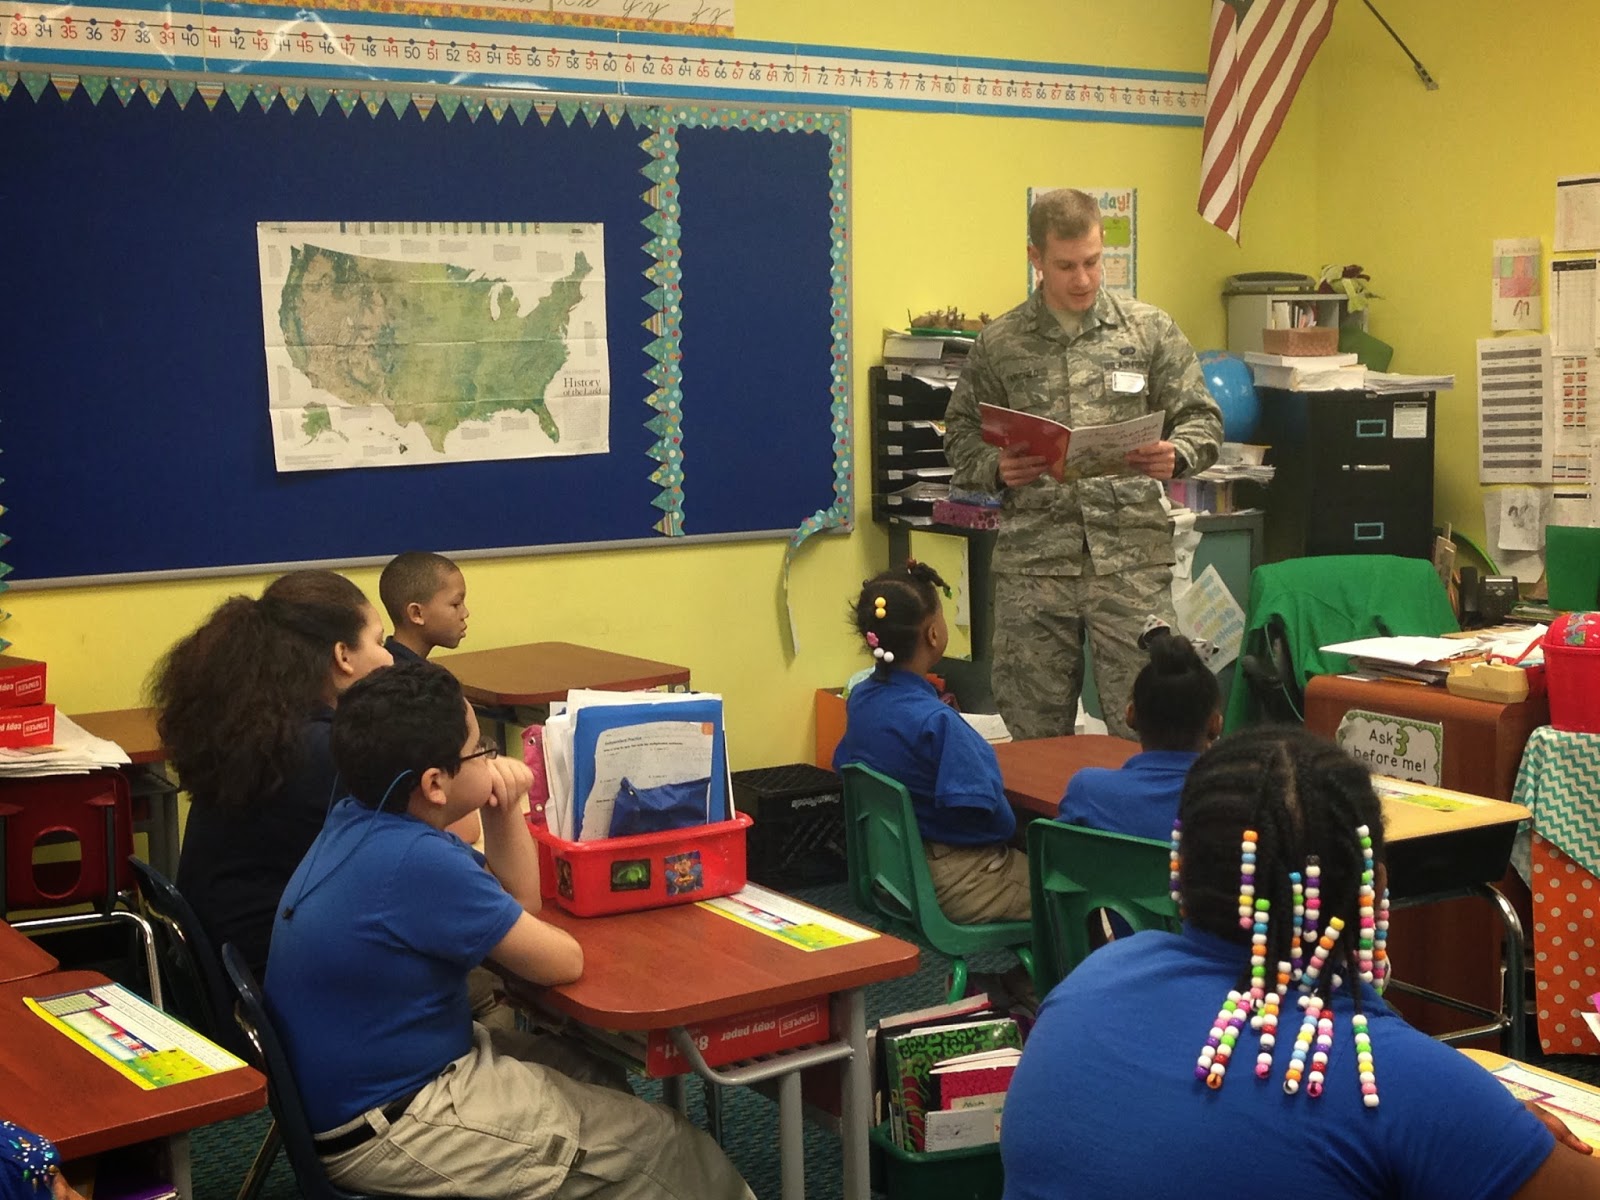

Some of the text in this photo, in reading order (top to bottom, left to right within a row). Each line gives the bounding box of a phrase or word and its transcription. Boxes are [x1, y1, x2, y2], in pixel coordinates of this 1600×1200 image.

[10, 22, 27, 37] 33
[35, 23, 52, 38] 34
[60, 25, 78, 40] 35
[86, 26, 102, 41] 36
[110, 28, 126, 43] 37
[135, 29, 151, 44] 38
[159, 31, 176, 46] 39
[182, 32, 199, 47] 40
[208, 34, 221, 48] 41
[230, 35, 245, 50] 42
[252, 37, 269, 51] 43
[296, 40, 314, 54] 45
[319, 41, 335, 56] 46
[340, 42, 356, 57] 47
[361, 44, 377, 58] 48
[383, 45, 398, 60] 49
[404, 46, 421, 61] 50
[427, 47, 438, 61] 51
[446, 49, 460, 62] 52
[467, 50, 481, 63] 53
[487, 51, 501, 65] 54
[506, 52, 521, 66] 55
[527, 54, 541, 67] 56
[547, 55, 560, 69] 57
[566, 56, 580, 70] 58
[585, 58, 598, 71] 59
[603, 59, 617, 72] 60
[625, 60, 635, 73] 61
[642, 62, 655, 74] 62
[661, 63, 673, 75] 63
[678, 64, 691, 77] 64
[697, 65, 710, 78] 65
[714, 66, 727, 79] 66
[732, 67, 744, 80] 67
[749, 68, 761, 81] 68
[767, 70, 778, 82] 69
[783, 71, 794, 83] 70
[801, 72, 810, 84] 71
[817, 73, 828, 86] 72
[834, 74, 845, 86] 73
[850, 75, 862, 87] 74
[866, 76, 878, 88] 75
[883, 77, 894, 90] 76
[899, 78, 910, 91] 77
[915, 80, 926, 92] 78
[931, 81, 941, 93] 79
[945, 82, 955, 94] 80
[963, 83, 971, 95] 81
[976, 84, 987, 96] 82
[992, 85, 1002, 97] 83
[1006, 86, 1017, 98] 84
[1021, 87, 1032, 99] 85
[1036, 88, 1046, 100] 86
[1051, 88, 1061, 100] 87
[1065, 89, 1075, 101] 88
[1080, 90, 1090, 102] 89
[564, 377, 601, 389] History
[6, 723, 22, 731] copy
[25, 721, 47, 733] STAPLES
[1369, 727, 1410, 756] Ask 3
[1353, 746, 1427, 772] before me!
[782, 1011, 816, 1031] STAPLES
[720, 1021, 776, 1042] copy paper
